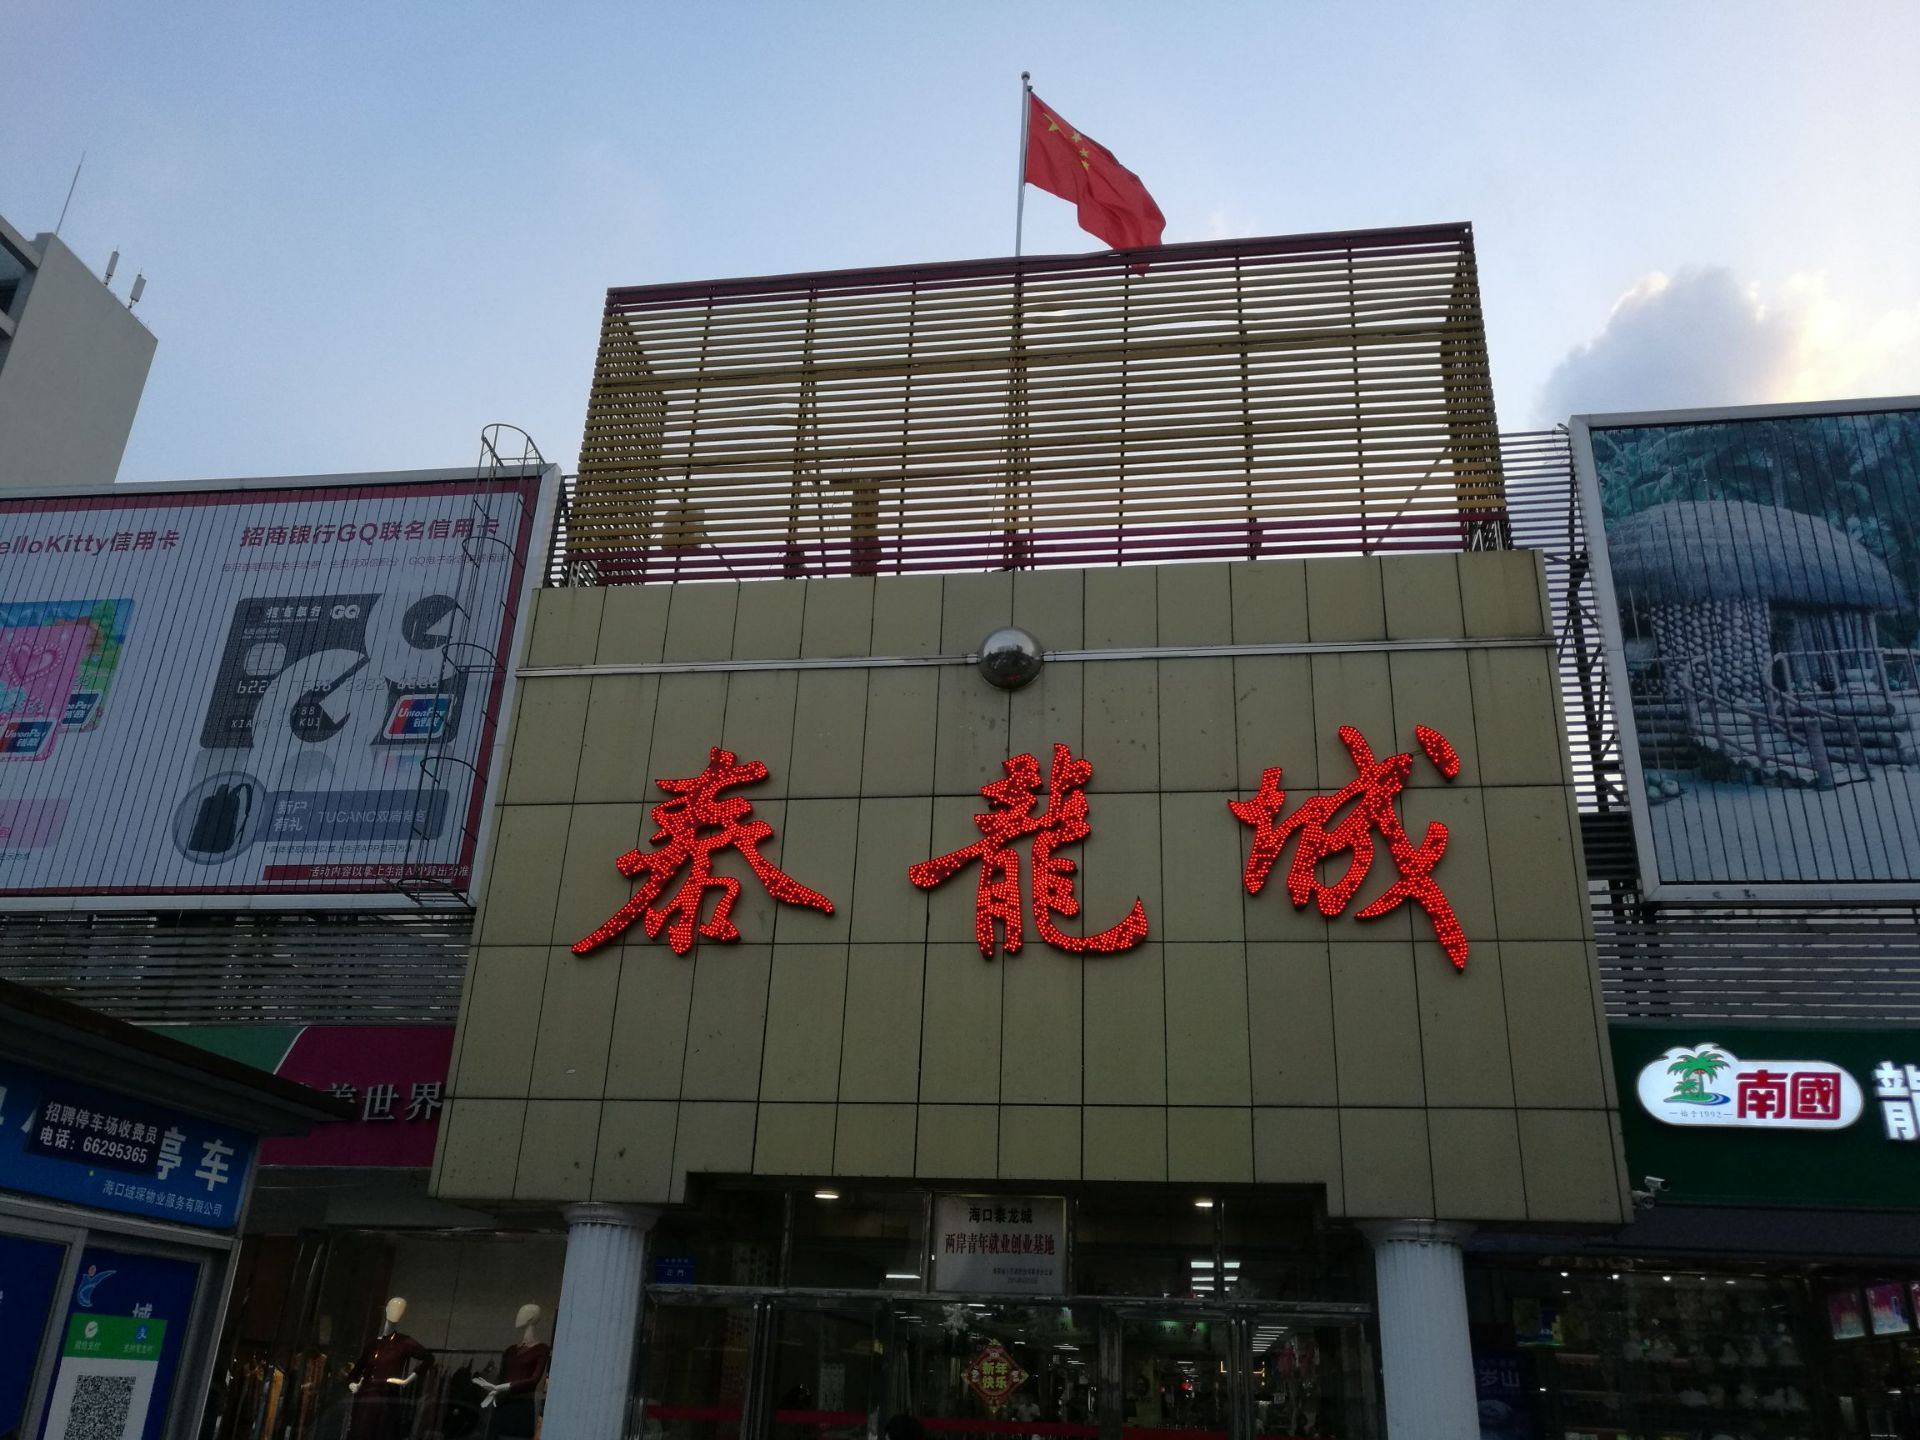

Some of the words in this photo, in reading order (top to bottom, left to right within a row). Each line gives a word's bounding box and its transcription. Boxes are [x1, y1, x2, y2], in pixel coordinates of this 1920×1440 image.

[241, 518, 501, 548] 招商银行GQ联名信用卡
[330, 604, 361, 620] GQ
[274, 816, 304, 832] 有礼
[1736, 1069, 1842, 1120] 南國
[45, 1101, 158, 1145] 招聘停车场收费员
[969, 1207, 1033, 1223] 海口泰龙城
[945, 1232, 1055, 1255] 两岸青年就业创业基地
[982, 1361, 1009, 1375] 新年
[982, 1375, 1008, 1390] 快乐
